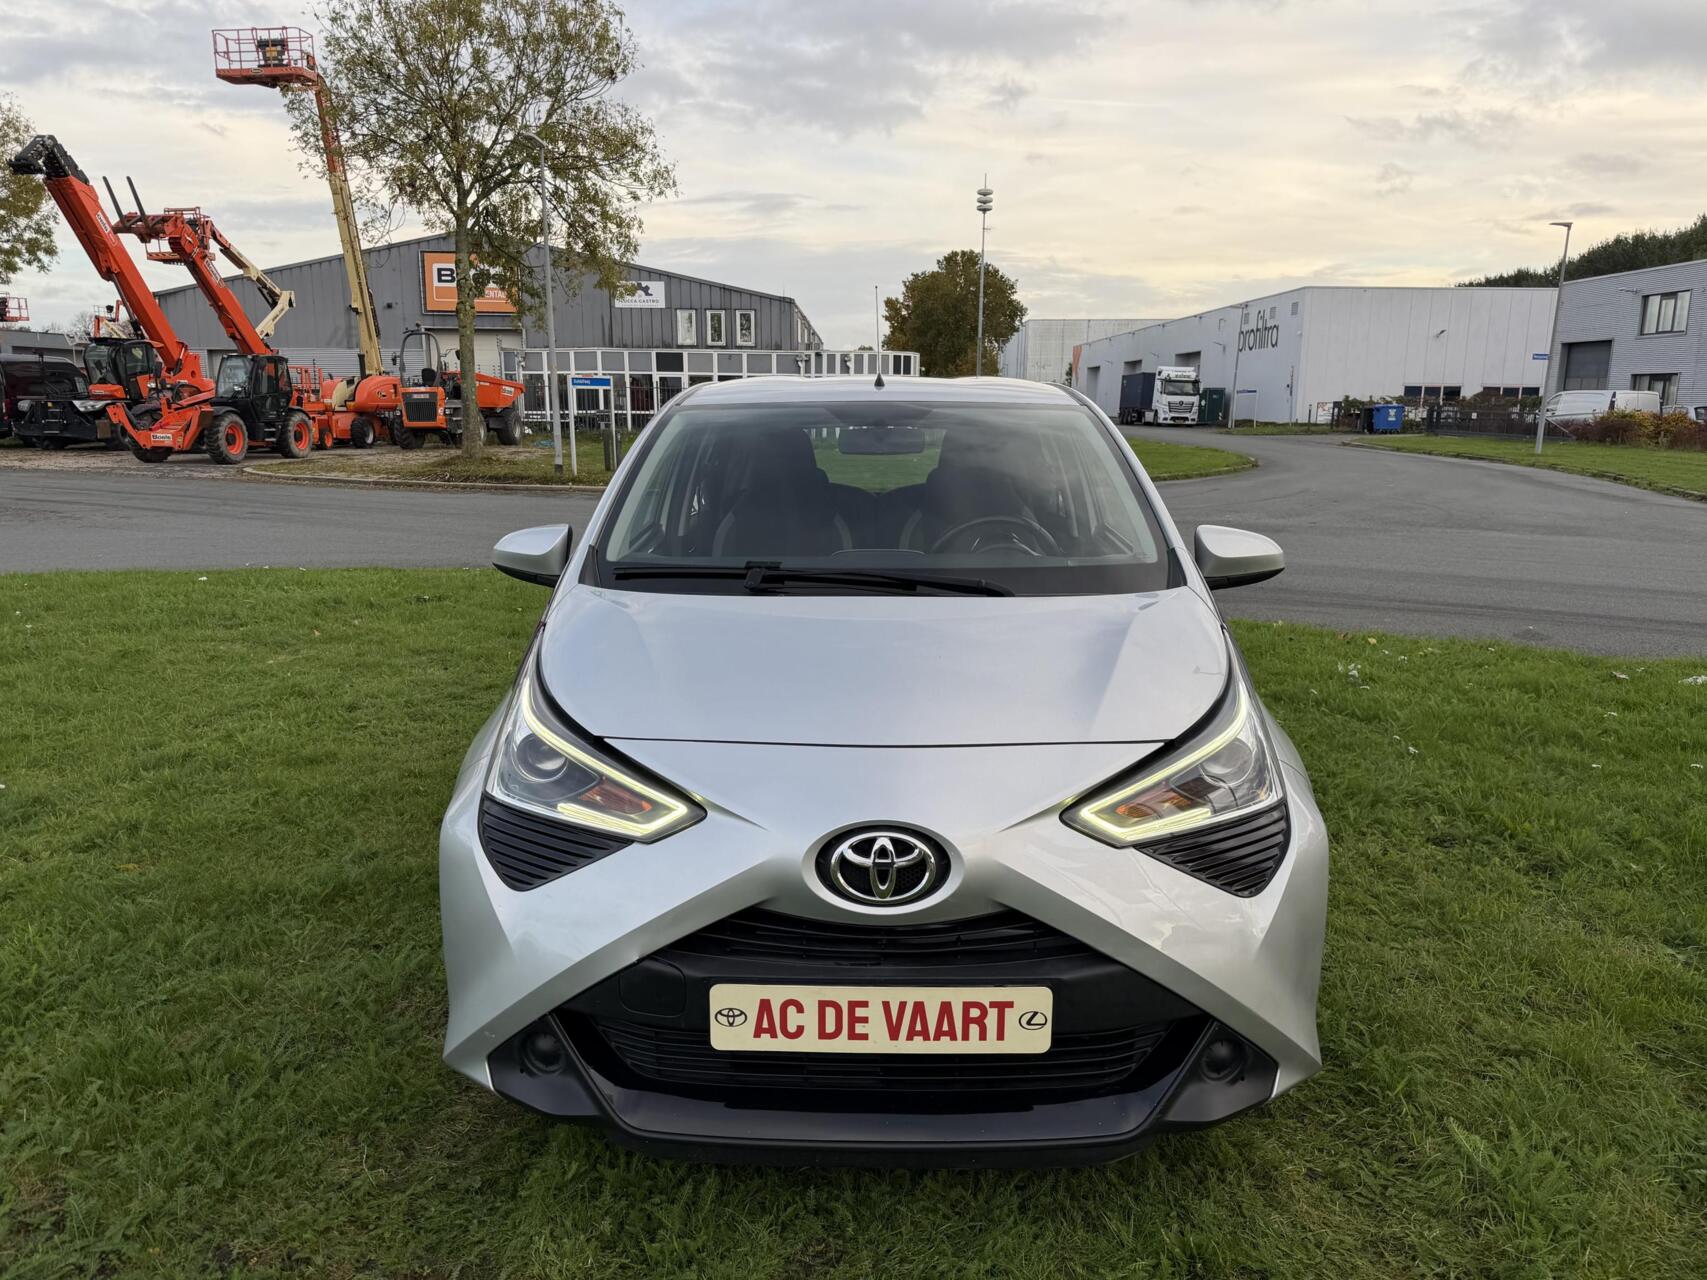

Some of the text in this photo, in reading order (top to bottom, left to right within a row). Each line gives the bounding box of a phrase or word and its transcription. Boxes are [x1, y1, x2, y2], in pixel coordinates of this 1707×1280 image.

[1237, 309, 1280, 354] profiltra
[753, 998, 1015, 1042] AC DE VAART
